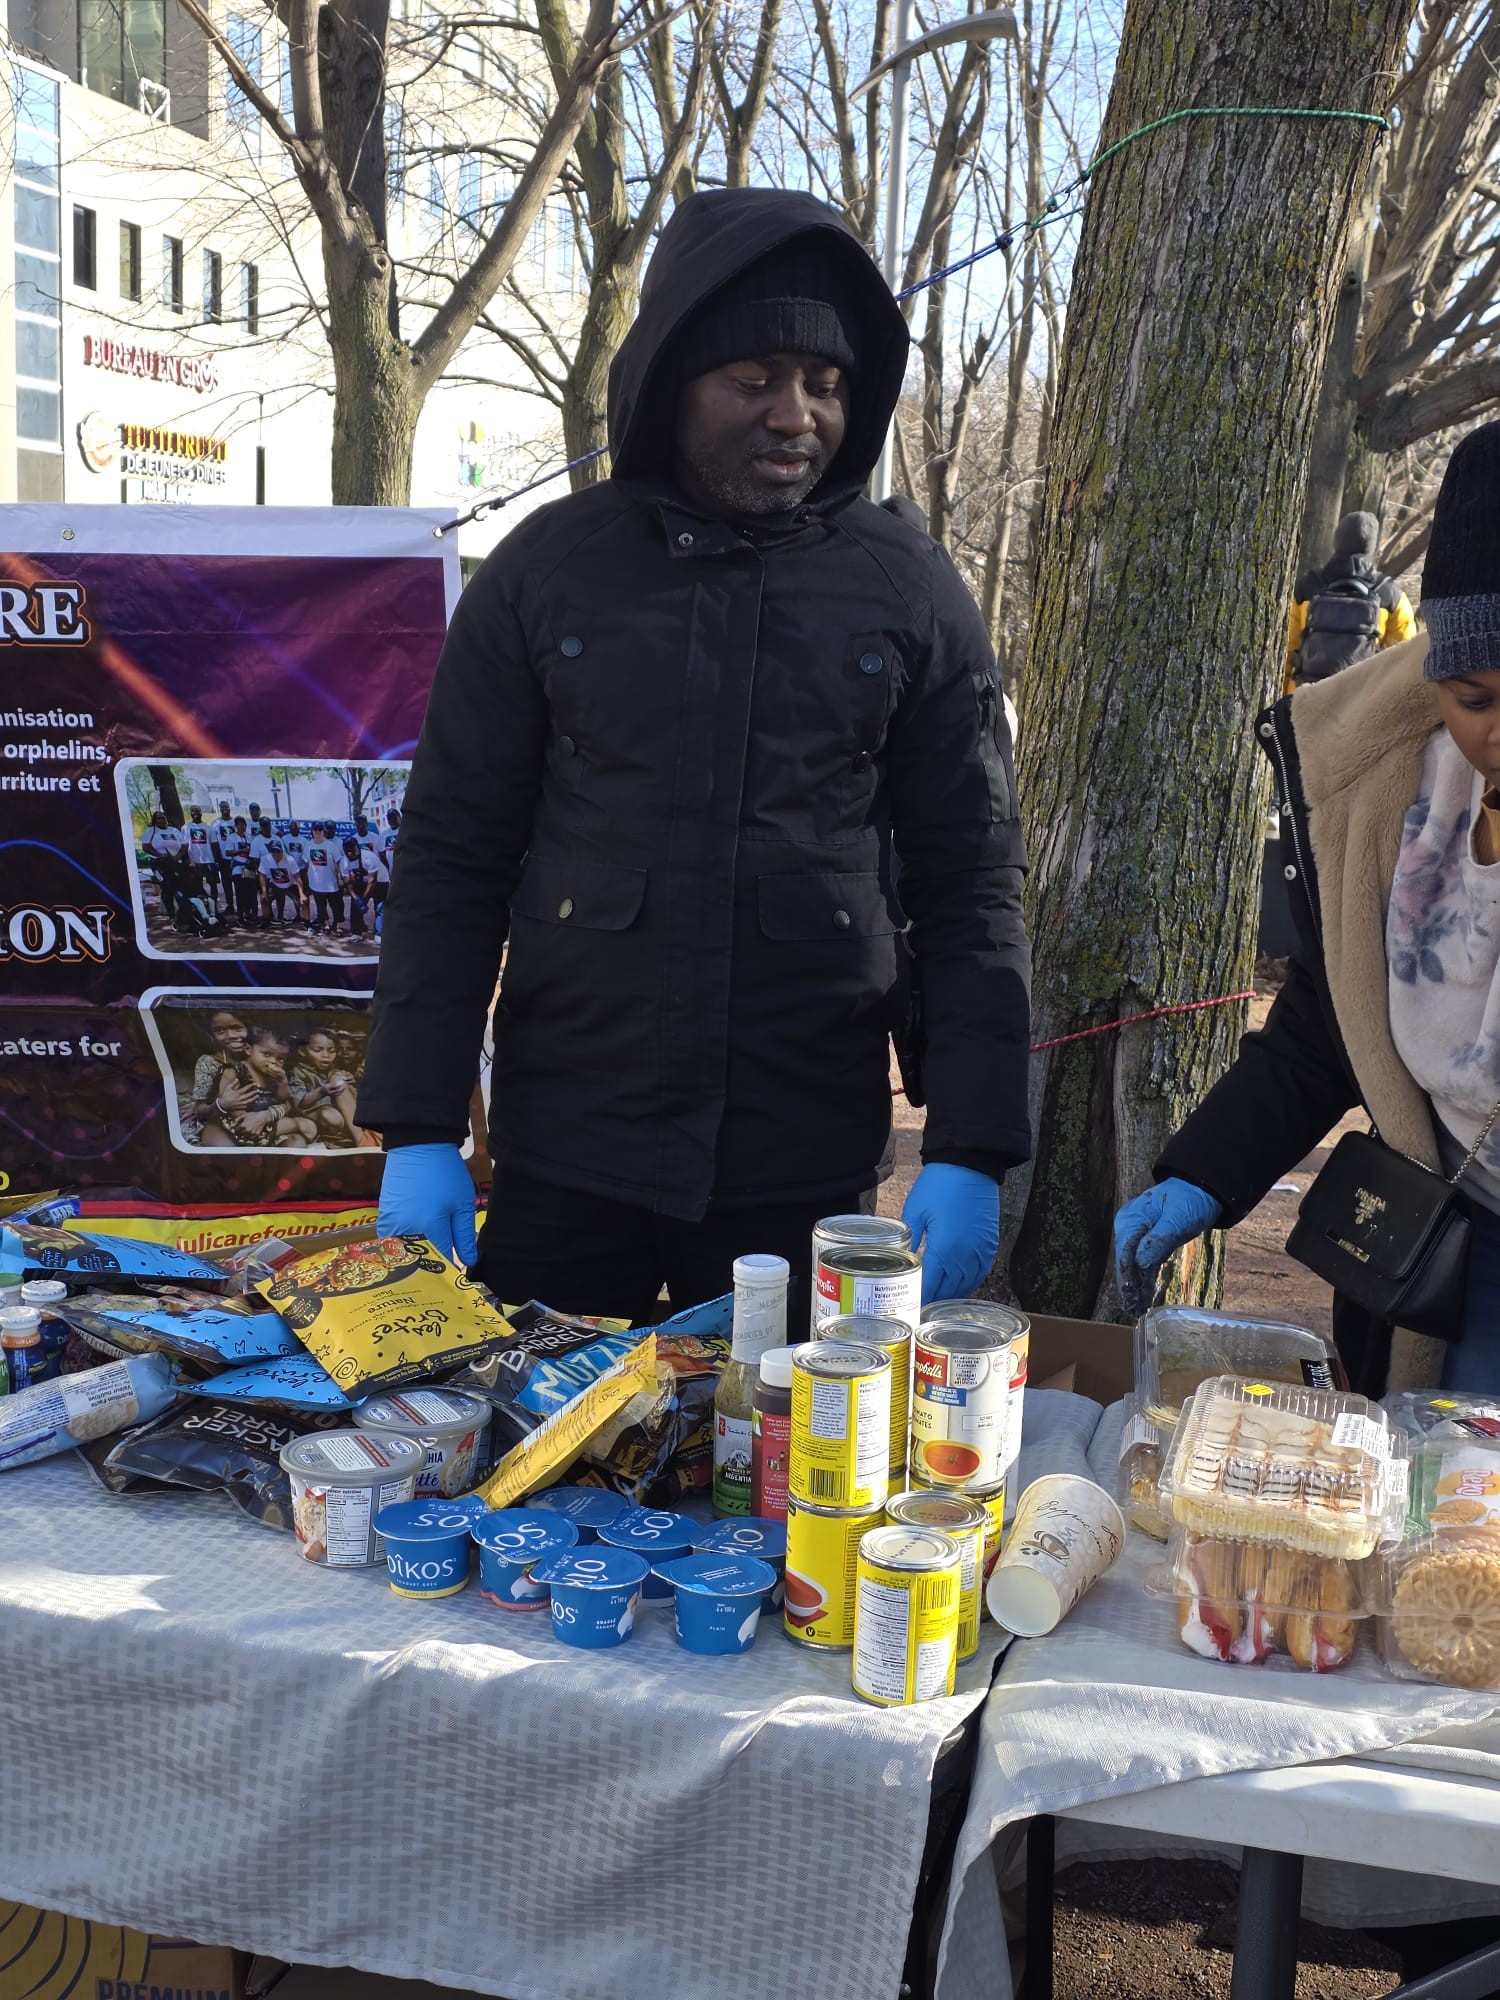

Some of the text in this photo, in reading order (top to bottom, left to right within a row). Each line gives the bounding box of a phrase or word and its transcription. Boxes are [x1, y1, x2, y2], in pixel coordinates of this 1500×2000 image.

[85, 335, 219, 393] BUREAU EN GROS
[0, 587, 83, 639] RE
[4, 739, 112, 764] orphelins,
[78, 775, 101, 792] et
[79, 1036, 122, 1057] for
[367, 1296, 417, 1314] Nature
[371, 1309, 450, 1344] Brutes
[499, 1330, 598, 1373] BARREL
[183, 1414, 283, 1453] ACKER
